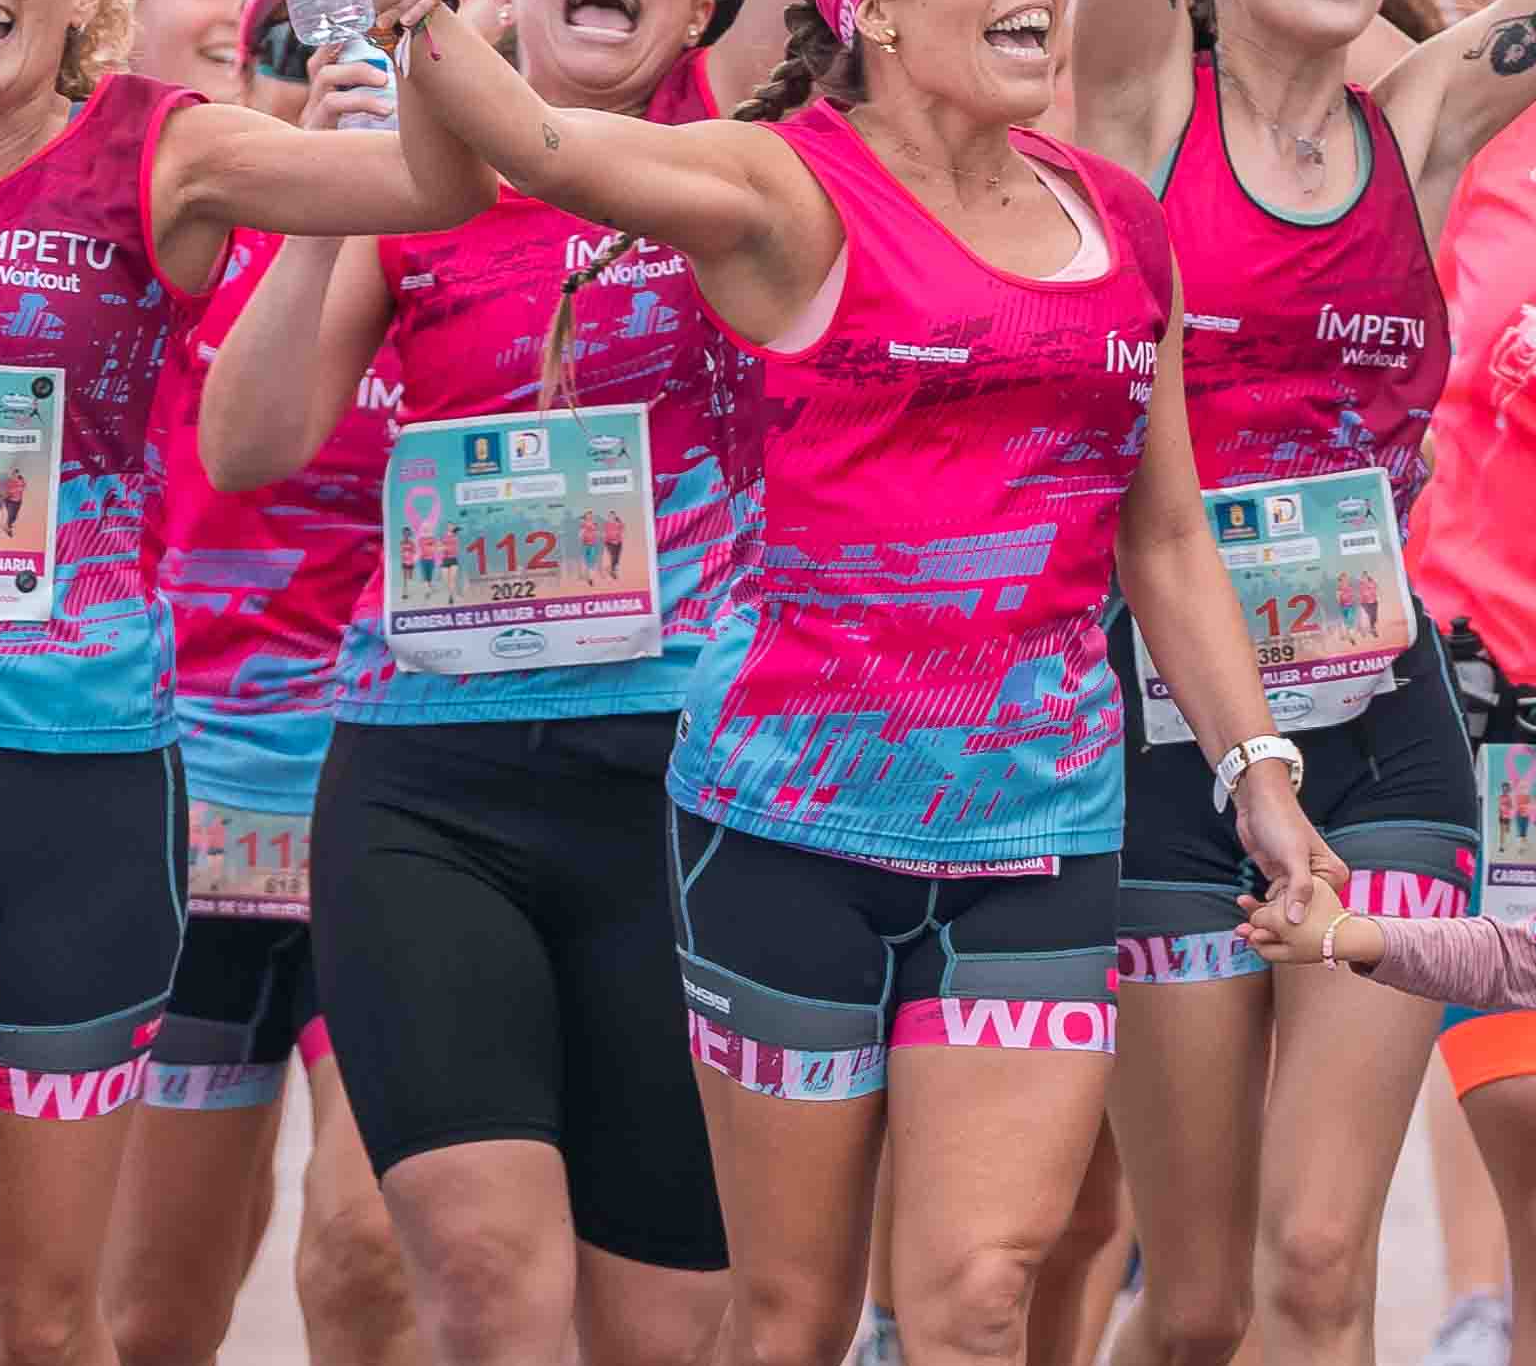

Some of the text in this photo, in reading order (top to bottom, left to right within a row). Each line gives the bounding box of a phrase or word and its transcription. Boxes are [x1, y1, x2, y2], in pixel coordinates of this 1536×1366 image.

[596, 254, 686, 287] Workout
[1316, 303, 1426, 348] ÍMPETU
[1341, 346, 1409, 371] Workout
[466, 530, 561, 575] 112
[491, 580, 537, 602] 2022
[395, 611, 455, 631] CARRERA
[456, 612, 475, 626] DE
[475, 610, 492, 625] LA
[545, 601, 582, 618] GRAN
[583, 597, 643, 615] CANARIA
[1311, 664, 1347, 680] GRAN
[235, 830, 310, 868] 11
